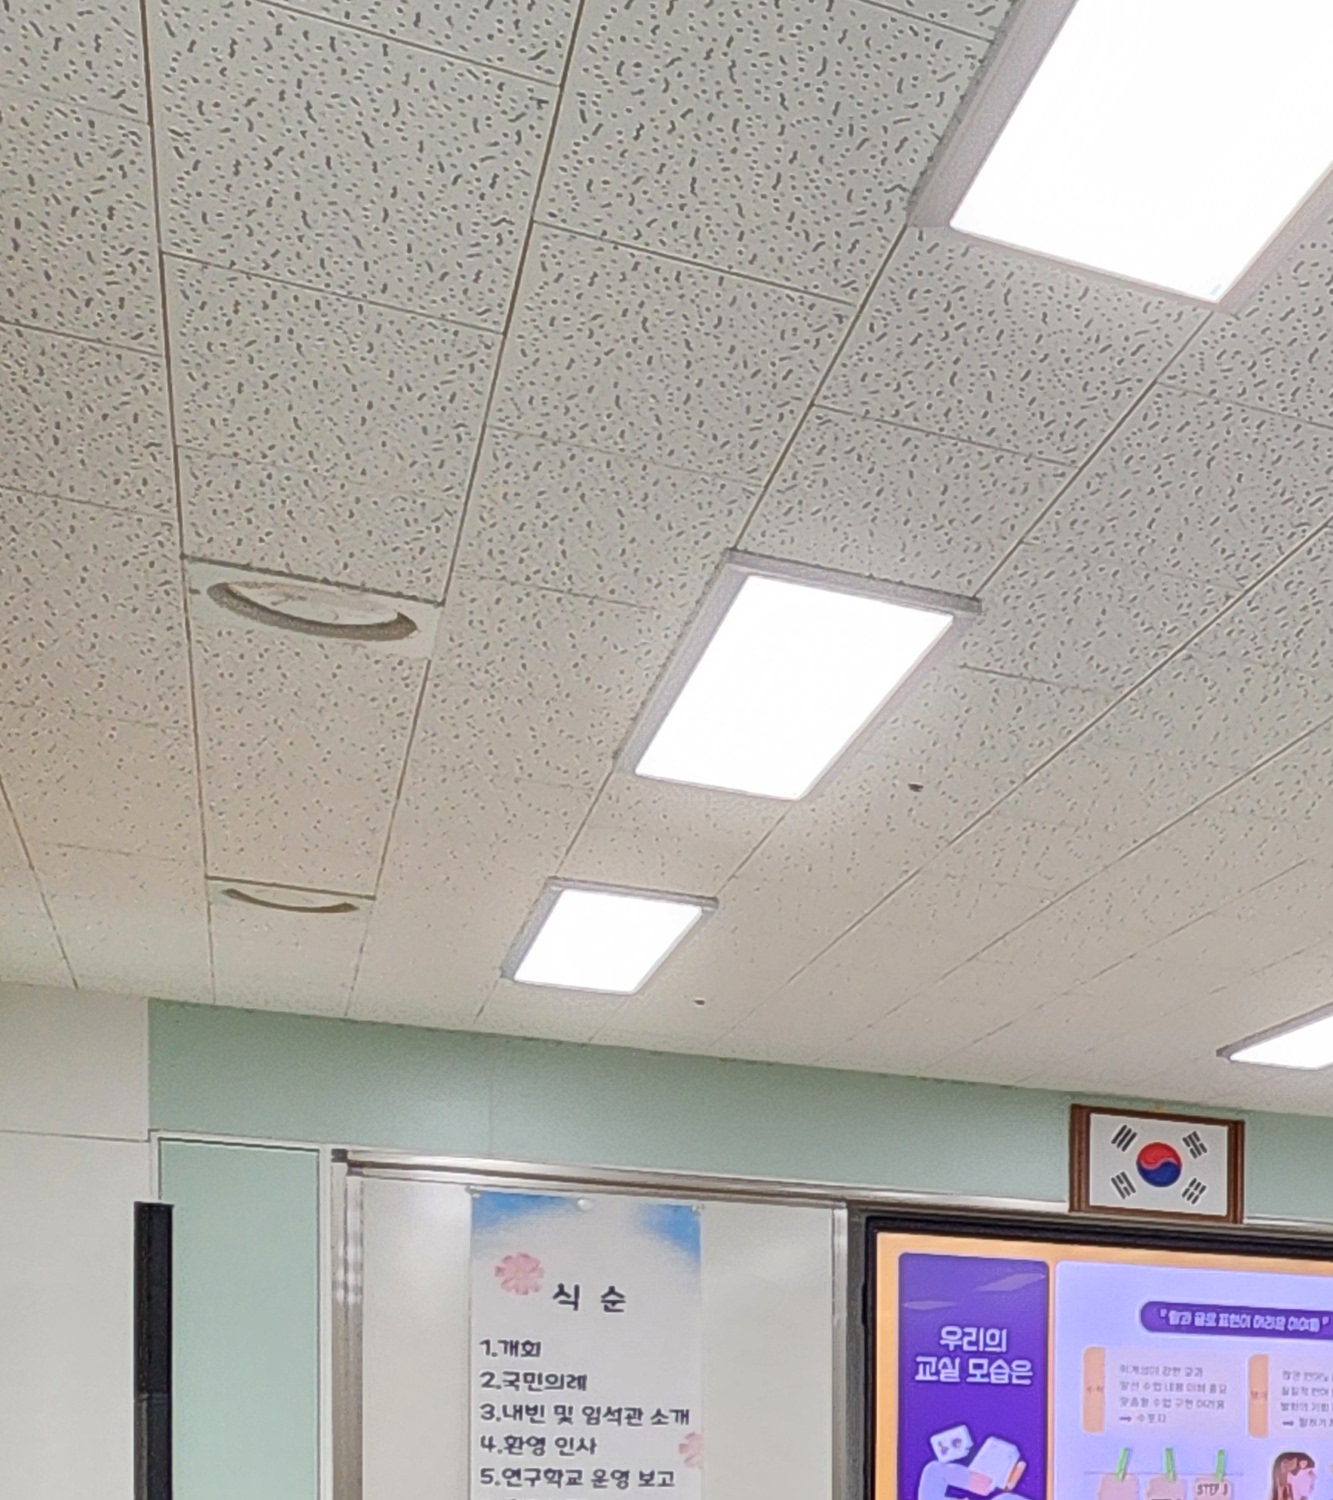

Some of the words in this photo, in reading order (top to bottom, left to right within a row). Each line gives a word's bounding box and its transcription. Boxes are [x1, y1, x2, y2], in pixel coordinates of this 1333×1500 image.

[552, 1282, 580, 1312] 식
[600, 1285, 627, 1313] 순
[480, 1339, 541, 1357] 1.개회
[939, 1326, 1008, 1352] 우리의
[480, 1371, 588, 1392] 2.국민의례
[914, 1355, 961, 1382] 교실
[966, 1358, 1033, 1385] 모습은
[480, 1403, 545, 1424] 3.내빈
[553, 1404, 574, 1425] 및
[582, 1406, 644, 1427] 임석관
[650, 1408, 690, 1426] 소개
[480, 1435, 546, 1457] 4.환영
[554, 1436, 597, 1456] 인사
[480, 1467, 584, 1488] 5.연구학교
[591, 1469, 630, 1490] 운영
[638, 1470, 676, 1488] 보고
